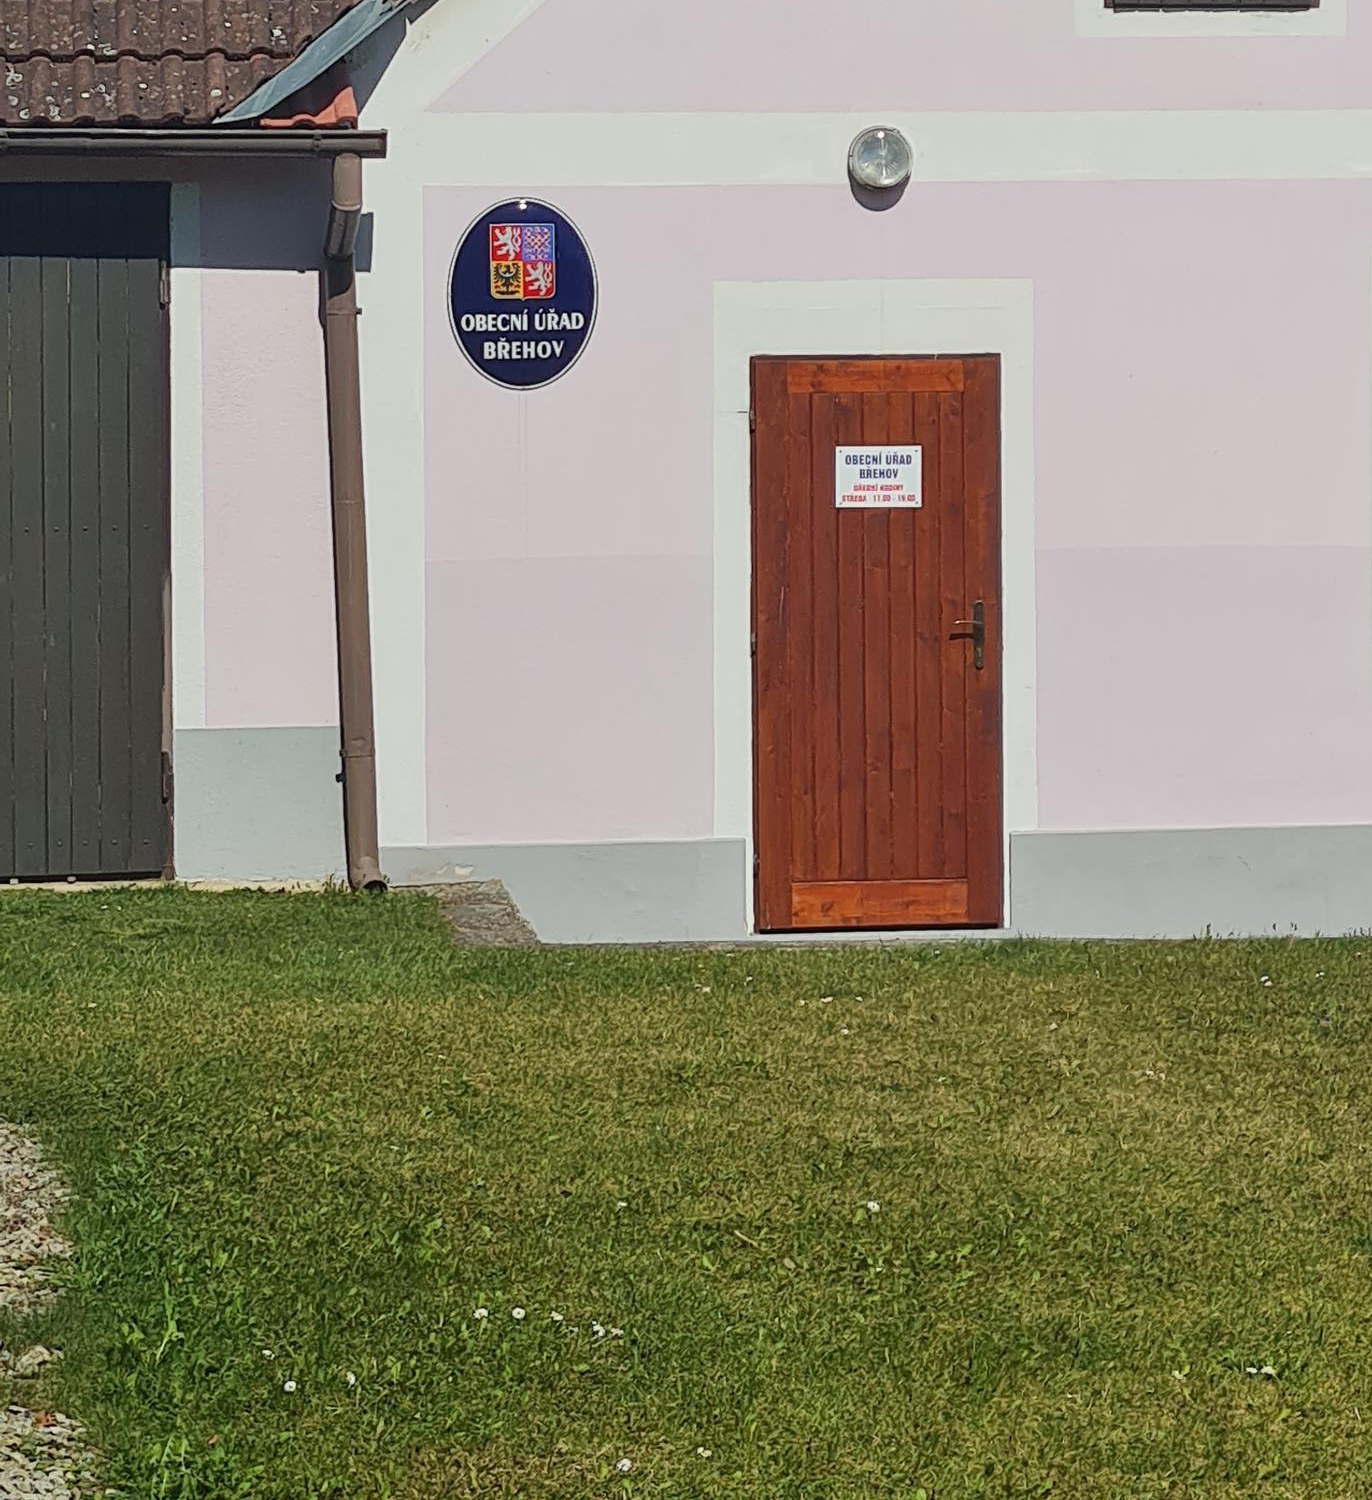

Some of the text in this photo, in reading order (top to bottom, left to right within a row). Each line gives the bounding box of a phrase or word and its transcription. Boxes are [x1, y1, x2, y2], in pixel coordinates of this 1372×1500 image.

[460, 308, 585, 332] OBECNÍ ÚŘAD
[483, 338, 565, 360] BŘEHOV
[845, 451, 912, 465] OBECNÍ ÚŘAD
[859, 466, 899, 479] BŘEHOV
